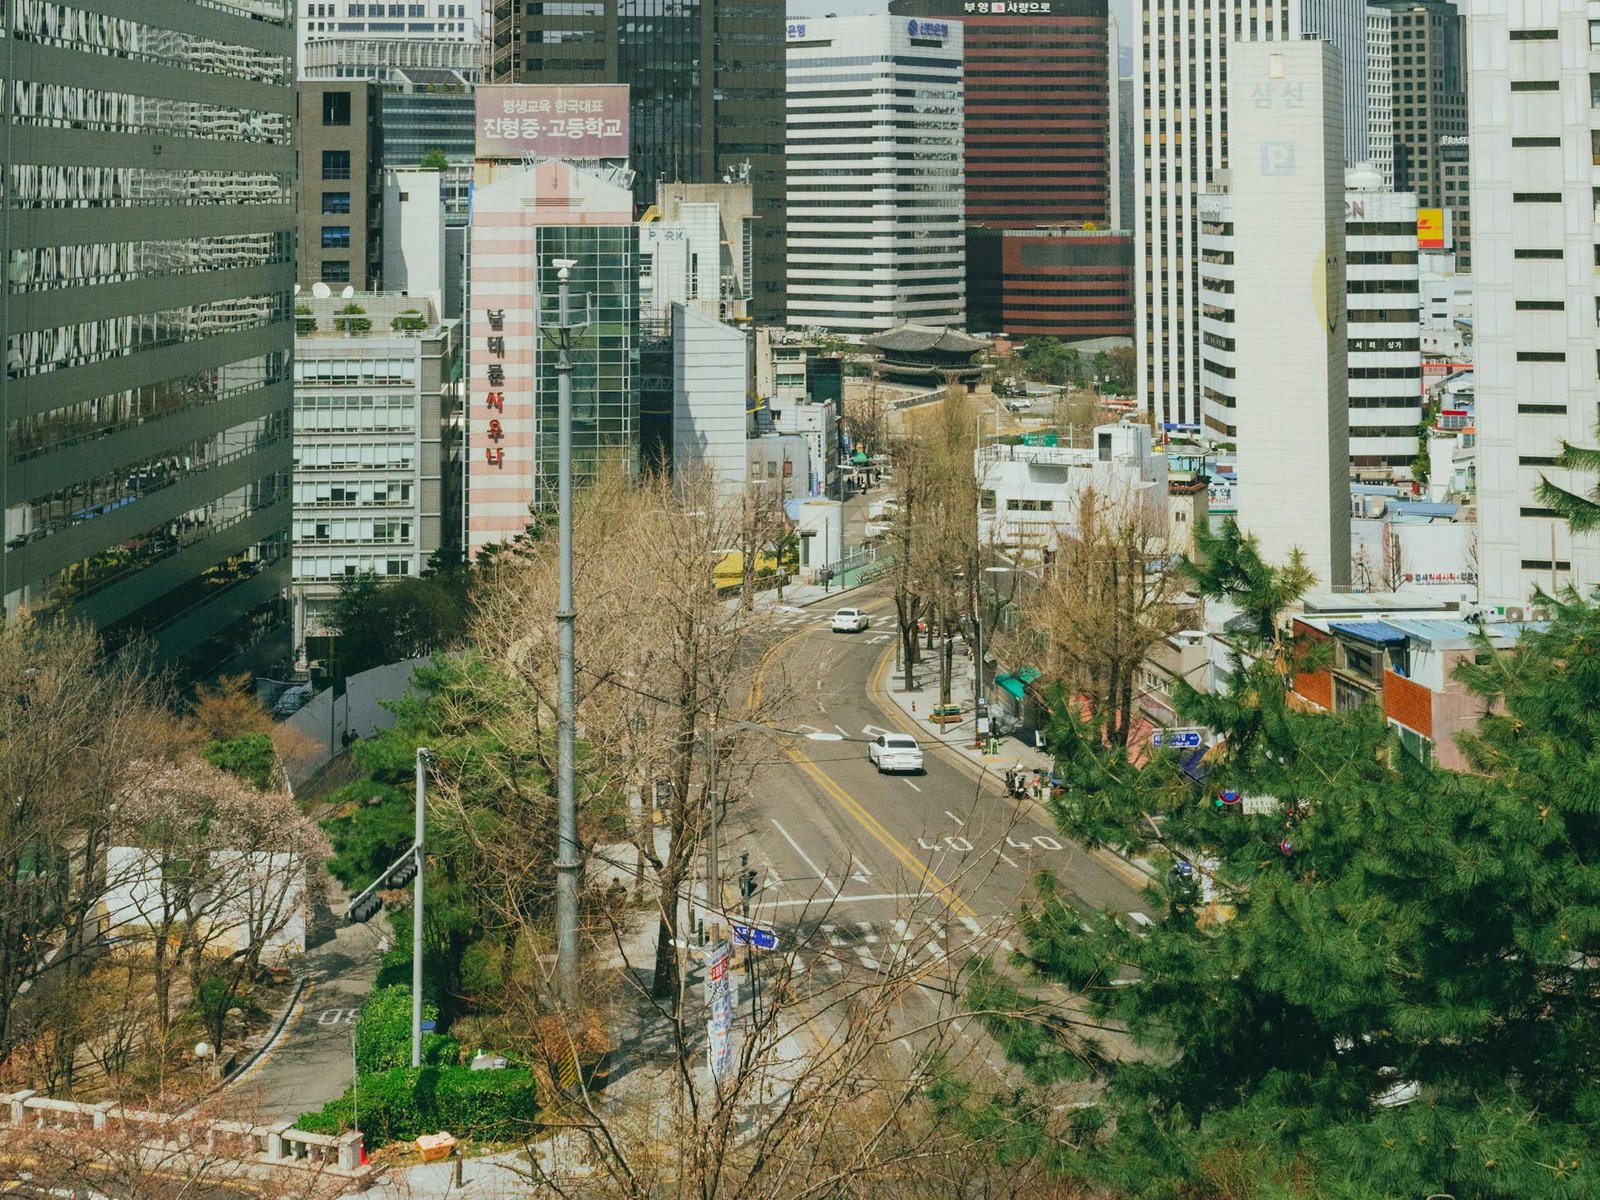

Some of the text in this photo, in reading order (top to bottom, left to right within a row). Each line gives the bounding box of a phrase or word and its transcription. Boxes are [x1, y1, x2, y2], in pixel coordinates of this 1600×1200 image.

[964, 2, 1052, 14] 부영 사랑으로
[787, 24, 806, 38] 은행
[920, 22, 948, 37] 신한은행
[502, 99, 604, 114] 평생교육 한국대표
[483, 117, 622, 140] 진형중·고등학교
[917, 836, 1063, 851] 40 40
